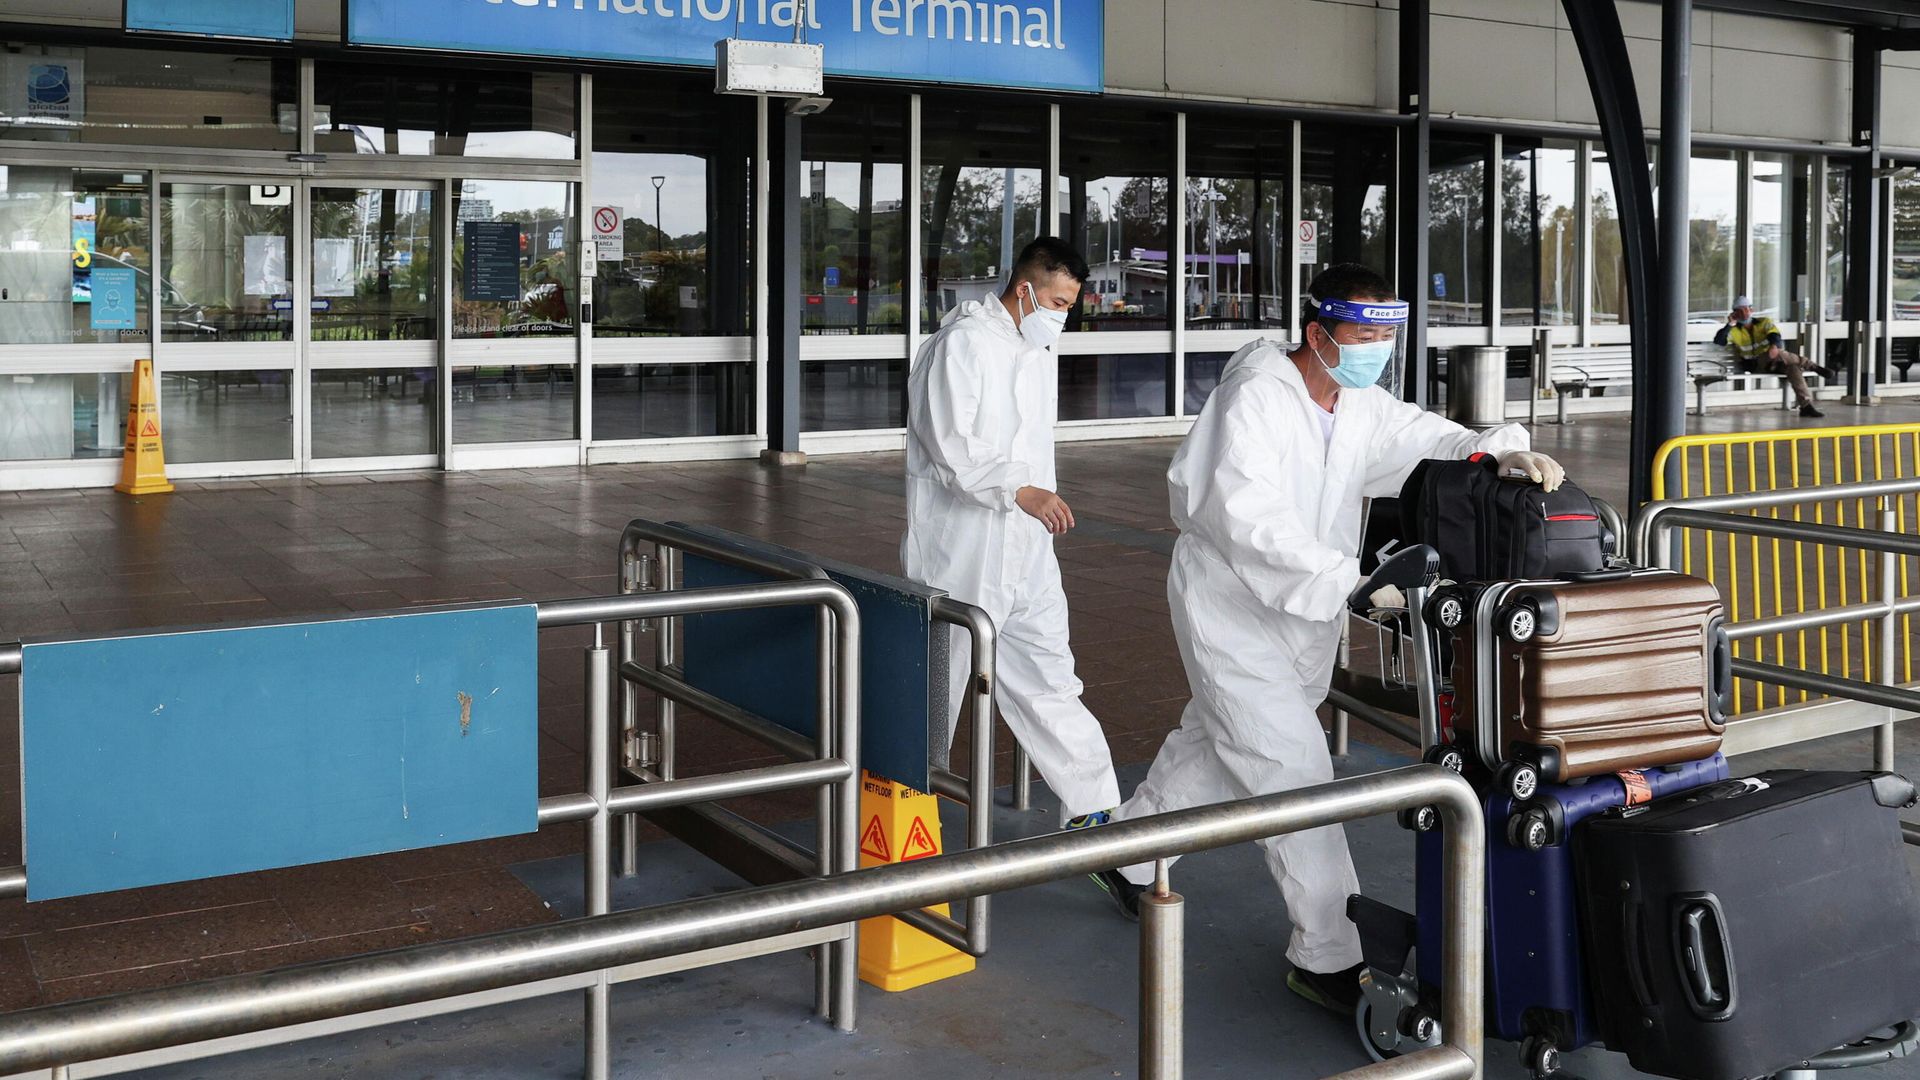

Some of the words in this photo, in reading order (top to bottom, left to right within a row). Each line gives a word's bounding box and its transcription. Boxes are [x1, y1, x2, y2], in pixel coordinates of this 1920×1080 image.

[1370, 309, 1390, 317] Face
[120, 328, 146, 336] doors
[453, 324, 477, 333] Please
[479, 324, 500, 332] stand
[501, 324, 519, 332] clear
[864, 782, 875, 793] WET
[875, 785, 893, 799] FLOOR
[900, 788, 911, 799] WET
